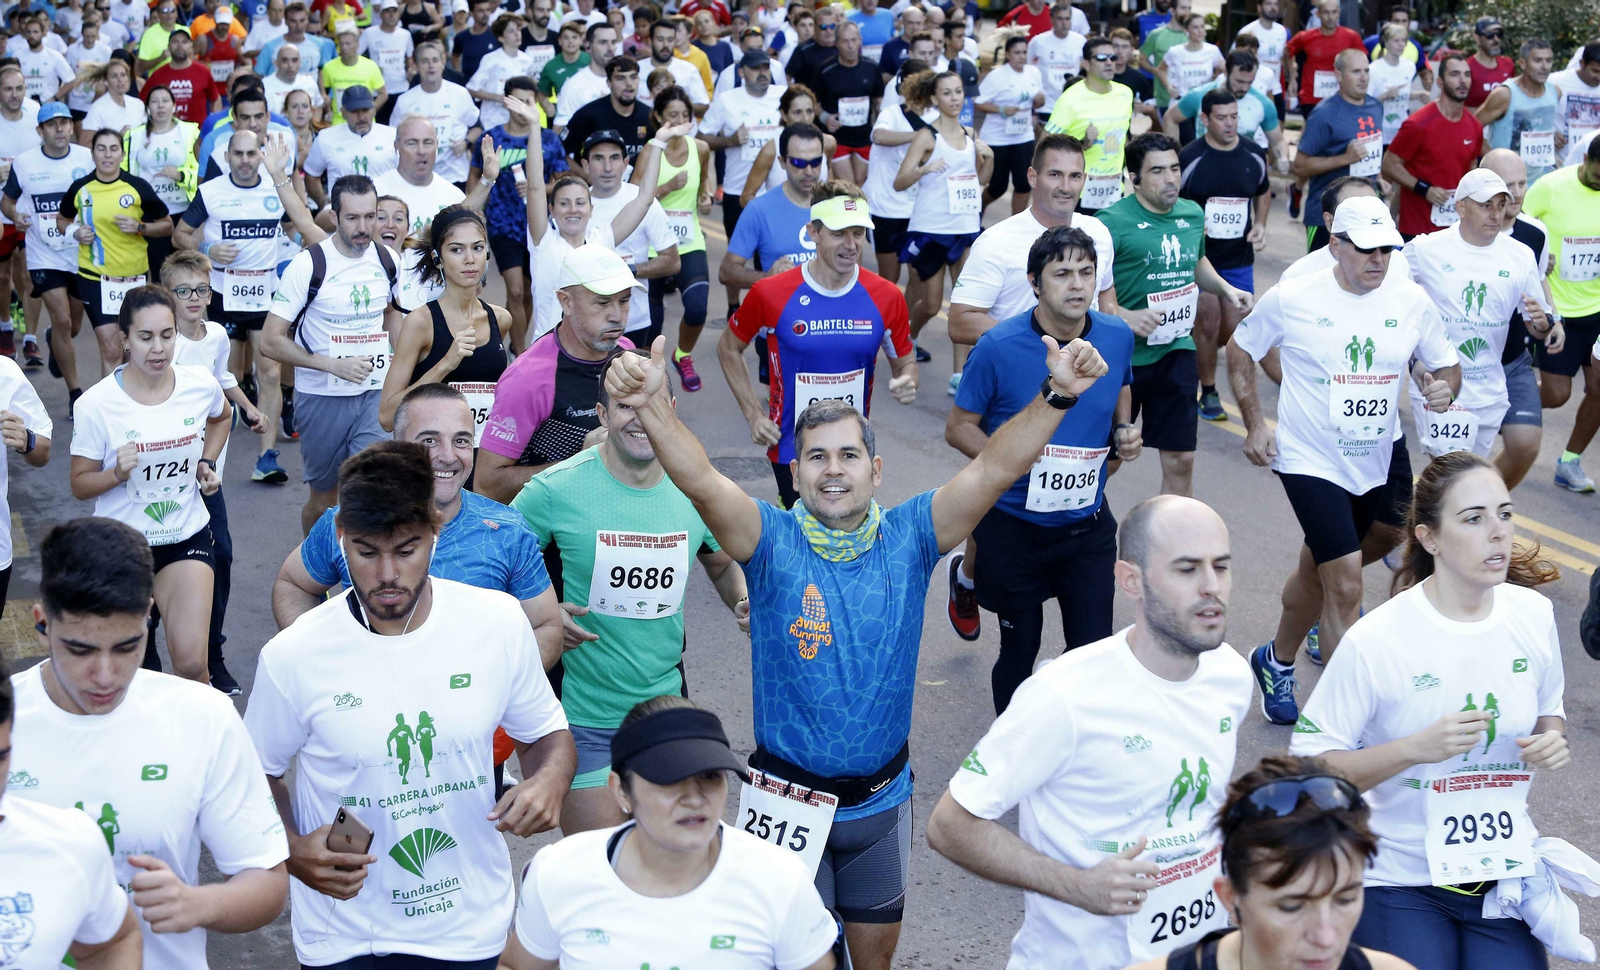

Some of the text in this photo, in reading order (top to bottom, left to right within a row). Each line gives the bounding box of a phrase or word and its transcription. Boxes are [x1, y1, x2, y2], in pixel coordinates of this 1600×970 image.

[1525, 145, 1552, 155] 18075
[956, 189, 977, 200] 1982
[1091, 186, 1115, 196] 3912
[1213, 213, 1241, 224] 9692
[232, 284, 264, 297] 9646
[810, 319, 853, 330] BARTELS
[798, 375, 810, 384] 41
[1333, 374, 1346, 384] 41
[1343, 399, 1387, 416] 3623
[489, 425, 515, 441] Trail
[1430, 423, 1469, 439] 3424
[1337, 438, 1379, 447] Fundación
[1343, 450, 1370, 458] Unicaja
[142, 458, 189, 481] 1724
[1038, 469, 1096, 490] 18036
[145, 526, 183, 536] Fundación
[598, 534, 686, 546] 41 CARRERA URBANA
[610, 566, 674, 589] 9686
[796, 616, 830, 633] aviva!
[789, 624, 832, 646] Running
[1412, 676, 1440, 687] 2020
[334, 695, 362, 707] 2020
[754, 782, 777, 794] CIUDAD
[1432, 779, 1446, 793] 41
[359, 780, 476, 808] 41 CARRERA URBANA
[744, 808, 810, 852] 2515
[1444, 811, 1513, 845] 2939
[392, 877, 459, 899] Fundación
[404, 897, 454, 917] Unicaja
[1150, 890, 1216, 944] 2698
